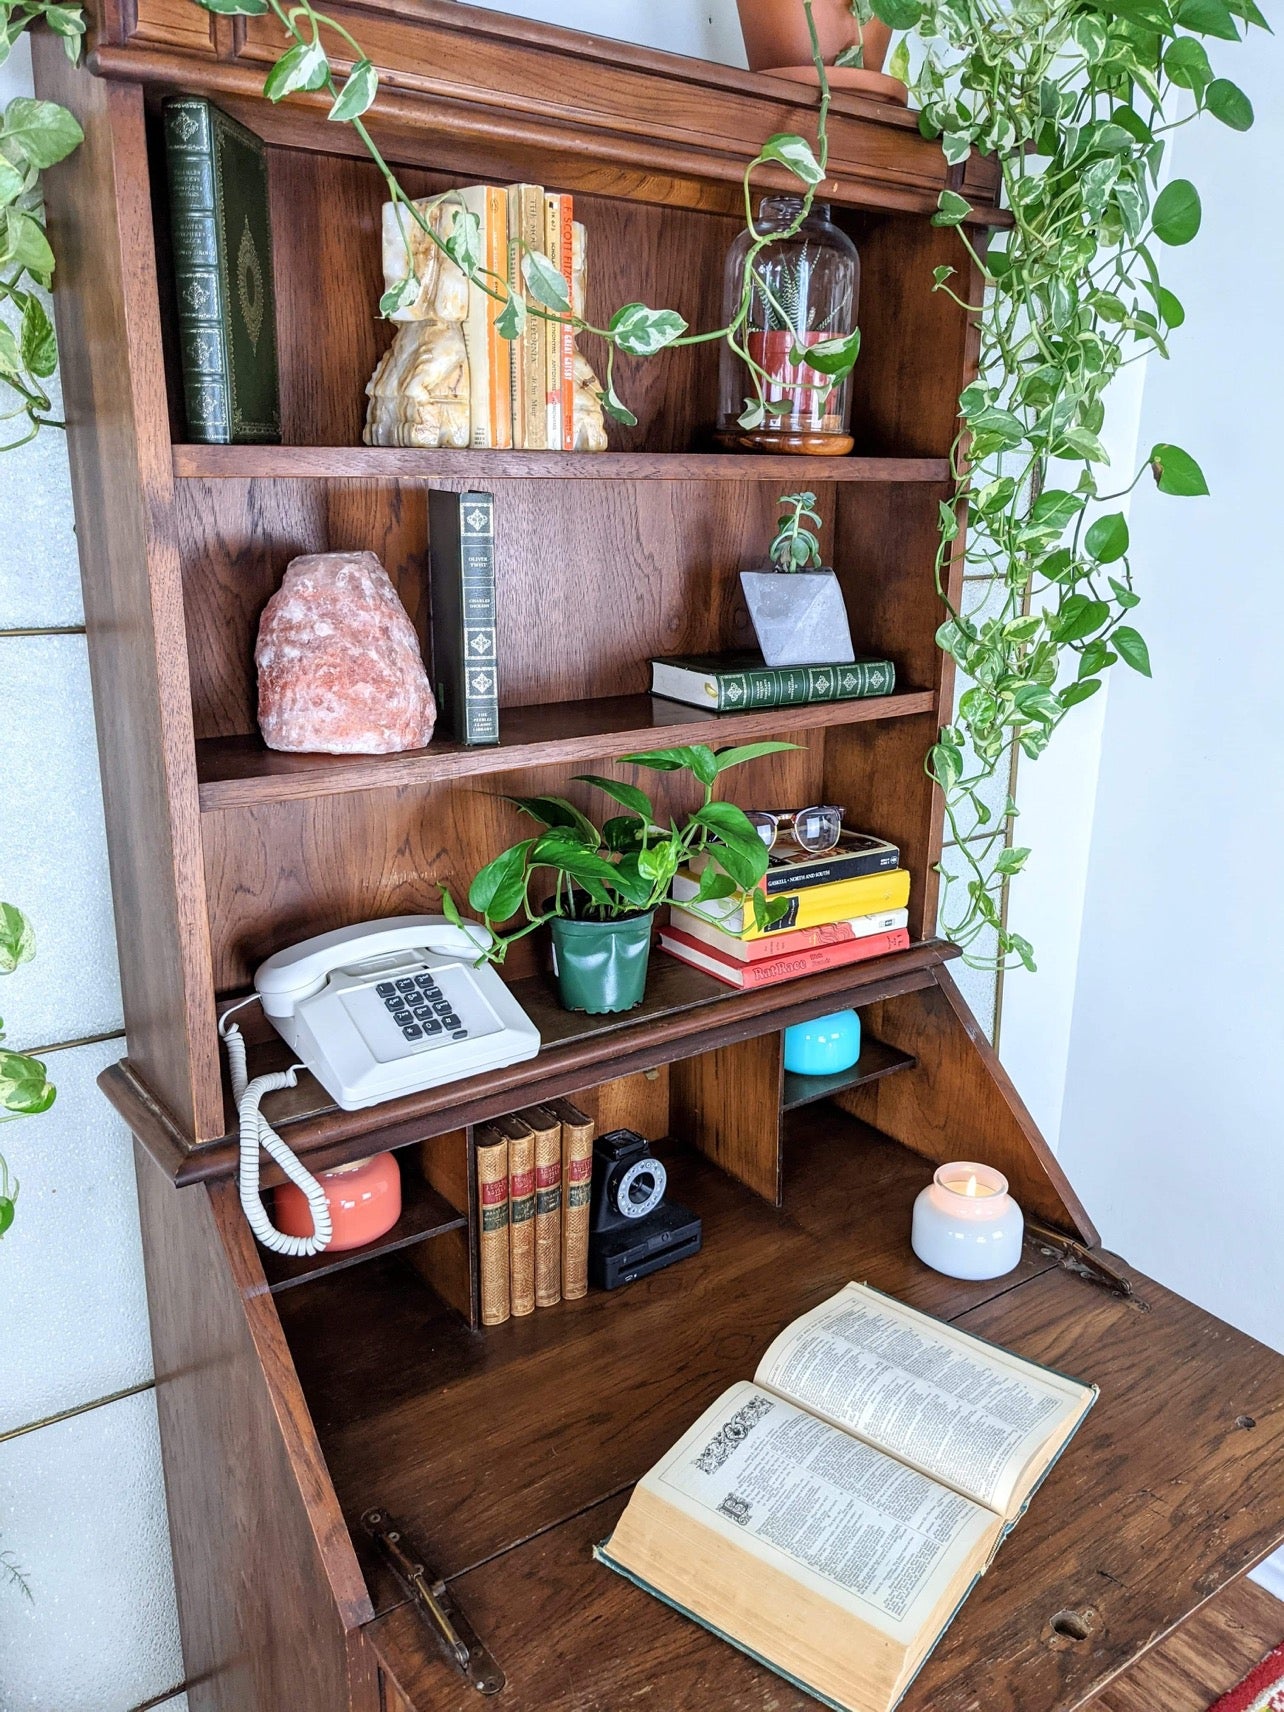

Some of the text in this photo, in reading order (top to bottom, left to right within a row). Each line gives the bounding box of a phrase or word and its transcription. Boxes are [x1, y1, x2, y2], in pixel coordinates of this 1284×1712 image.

[563, 217, 572, 252] SCOTT
[564, 335, 572, 354] GREAT
[564, 357, 573, 381] GATSBY
[767, 878, 787, 886] GASKELL
[789, 874, 806, 882] NORTH
[814, 869, 831, 878] SOUTH
[753, 958, 807, 981] Rat Race
